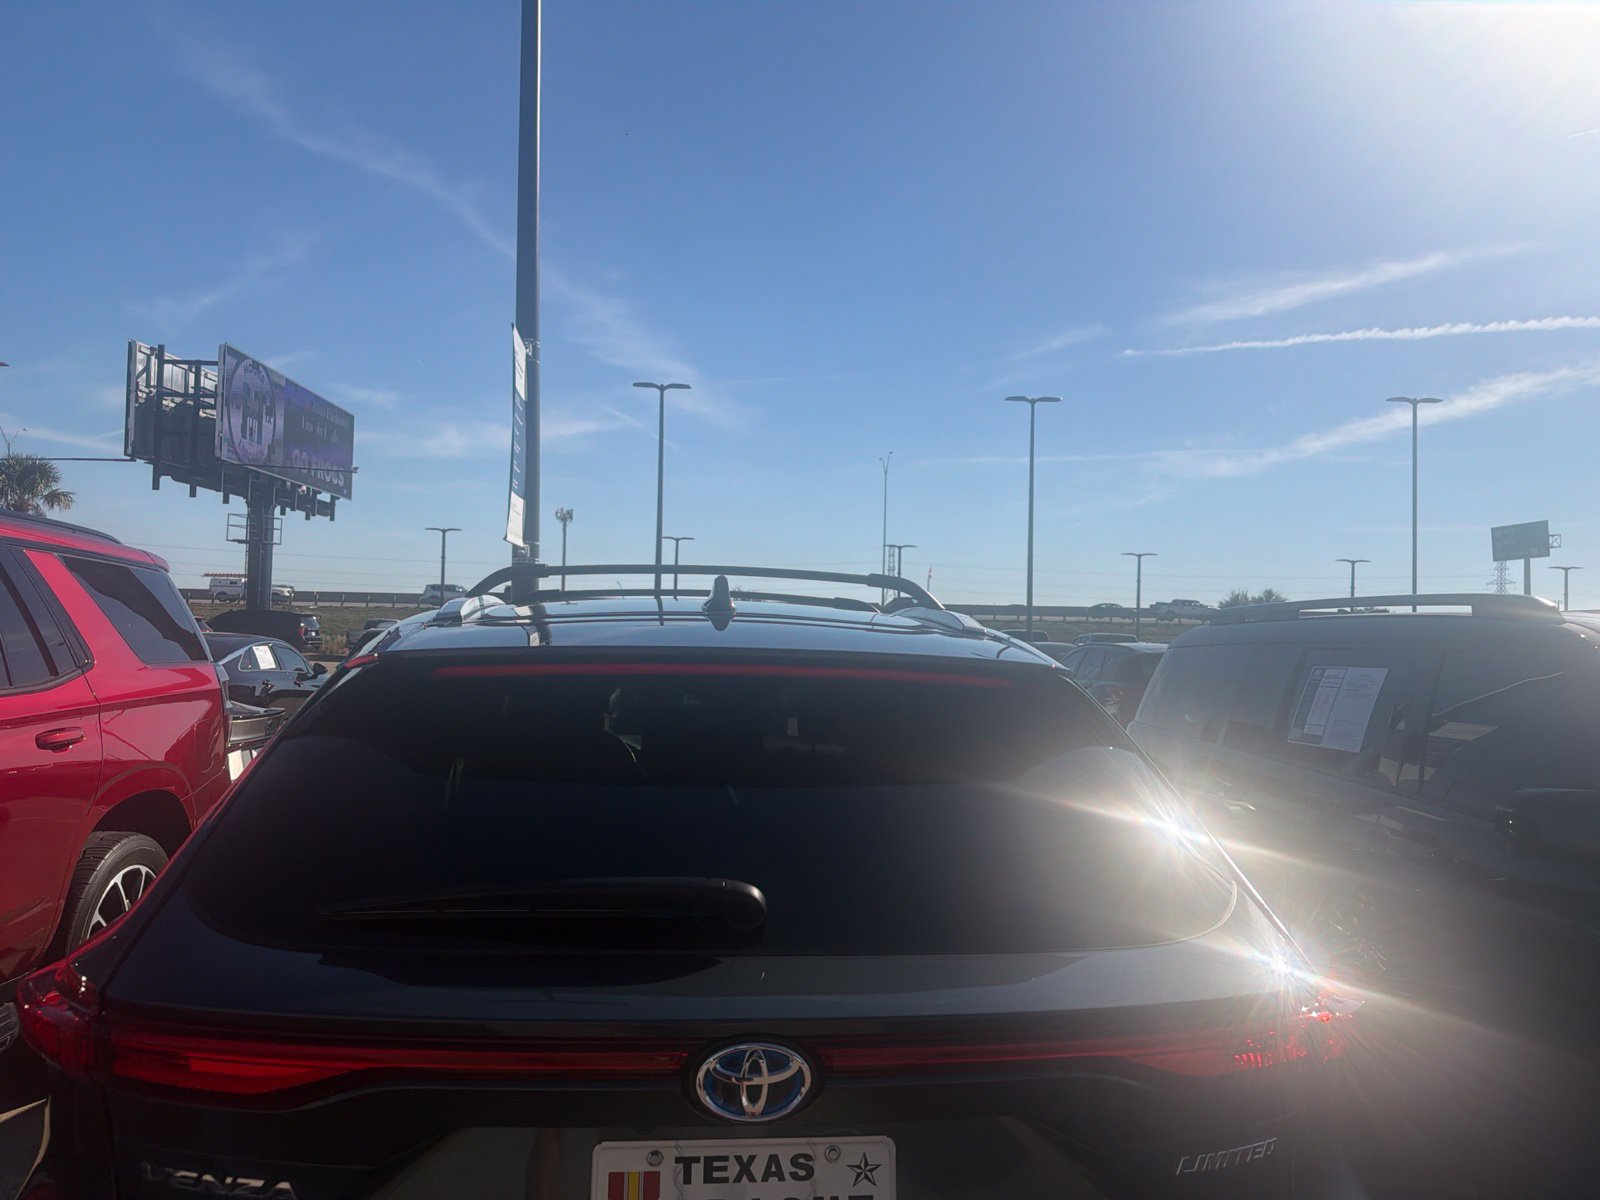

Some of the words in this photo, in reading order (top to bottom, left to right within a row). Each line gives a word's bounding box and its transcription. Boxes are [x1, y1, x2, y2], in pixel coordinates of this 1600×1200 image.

[310, 456, 345, 487] FROGS
[674, 1152, 816, 1185] TEXAS
[1175, 1137, 1278, 1176] LIMITED
[140, 1162, 297, 1200] VENZA
